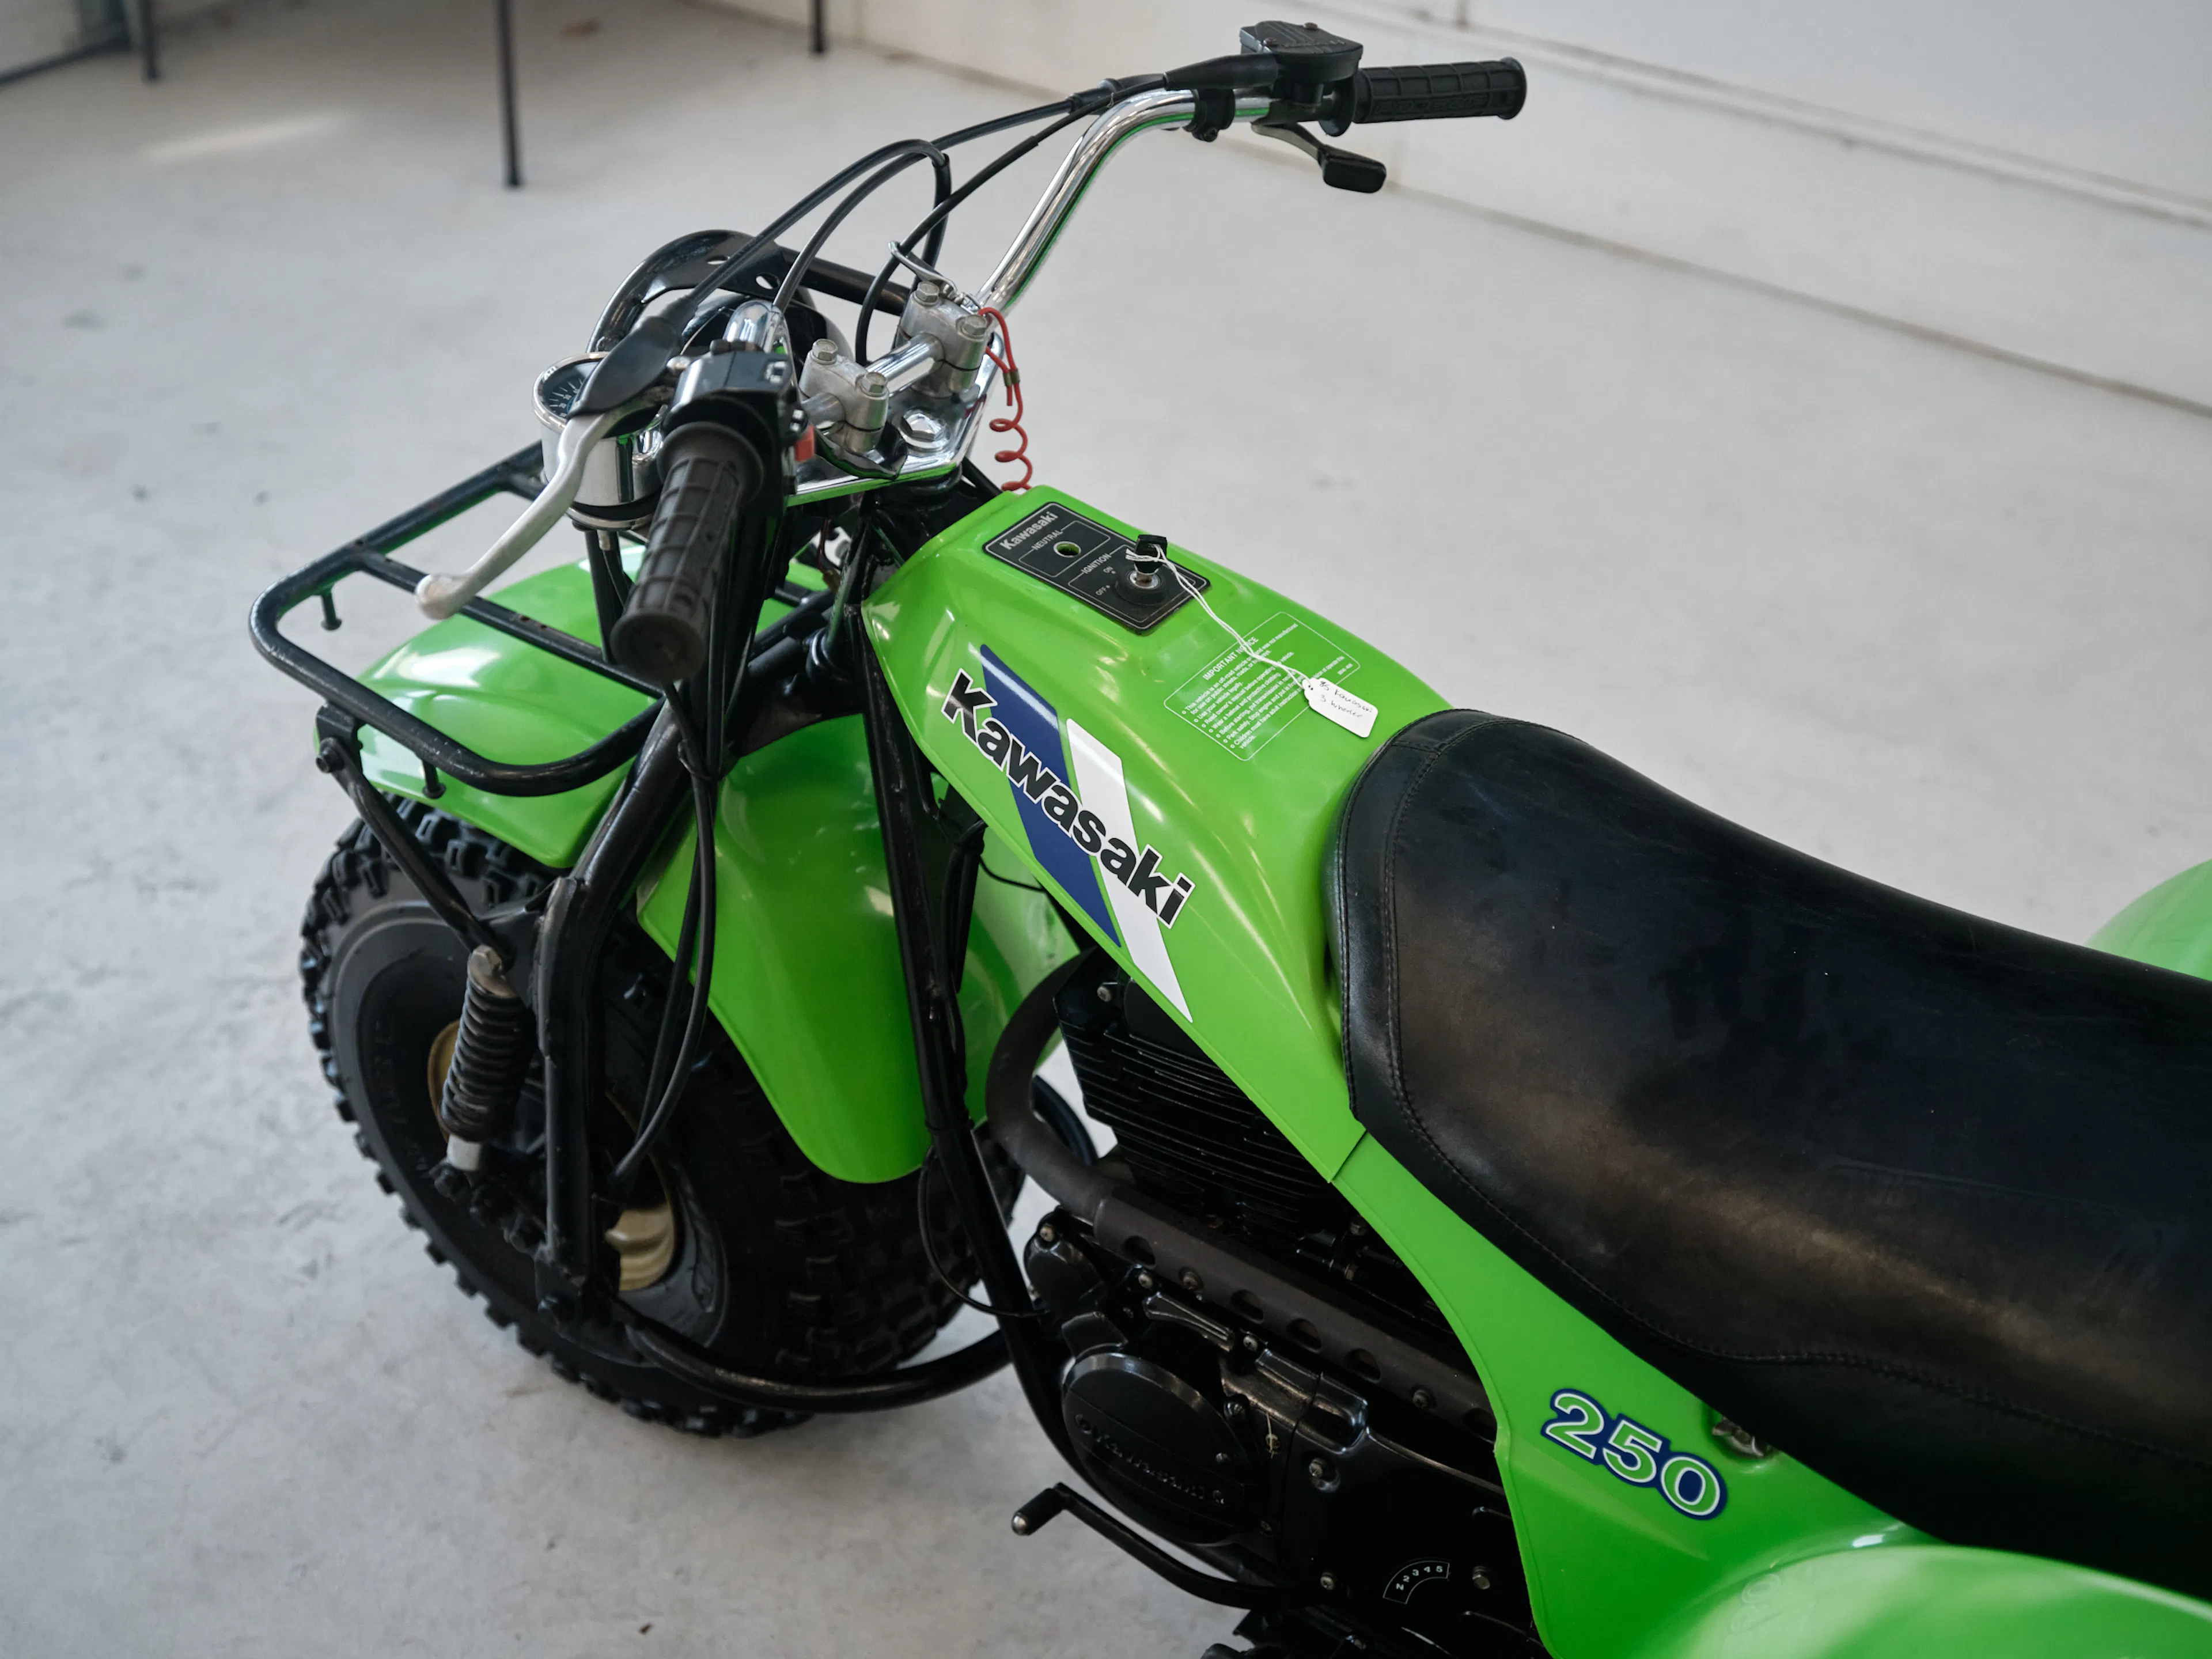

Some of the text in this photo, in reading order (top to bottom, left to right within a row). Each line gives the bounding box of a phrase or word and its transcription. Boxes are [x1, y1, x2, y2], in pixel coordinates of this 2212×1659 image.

[999, 511, 1058, 550] Kawasaki
[1031, 529, 1063, 551] NEUTRAL
[1081, 552, 1112, 574] IGNITION
[1103, 566, 1113, 574] ON
[1095, 586, 1107, 596] OFF
[1184, 702, 1197, 710] This
[1194, 690, 1211, 703] vehicle
[1218, 669, 1235, 683] off-road
[1233, 660, 1248, 671] vehicle
[1202, 652, 1237, 680] IMPORTANT
[1196, 700, 1207, 710] use
[1210, 687, 1224, 699] public
[1222, 676, 1238, 688] streets,
[1196, 681, 1243, 719] Use your vehicle legally.
[1203, 713, 1217, 724] Read
[1215, 700, 1232, 715] owner's
[1230, 688, 1246, 702] manual
[1243, 679, 1257, 690] before
[1256, 666, 1275, 680] operating
[1211, 718, 1224, 729] Wear
[1225, 704, 1241, 717] helmet
[1238, 698, 1248, 706] and
[1246, 683, 1266, 700] protective
[1218, 721, 1234, 734] Before
[1233, 709, 1251, 723] starting,
[1248, 702, 1257, 711] put
[1254, 684, 1279, 704] transmission
[1320, 694, 1327, 702] 3
[1226, 730, 1238, 740] Park
[1236, 720, 1251, 732] safely.
[1248, 711, 1260, 721] Stop
[1257, 700, 1272, 713] engine
[1270, 694, 1280, 702] and
[1278, 688, 1286, 696] put
[1233, 729, 1252, 745] Children
[1250, 721, 1262, 731] must
[1259, 713, 1271, 723] have
[1269, 705, 1280, 715] adult
[1278, 690, 1298, 707] instruction
[1239, 734, 1256, 749] vehicle.
[941, 668, 1196, 929] Kawasaki
[1540, 1388, 1728, 1521] 250
[1403, 1575, 1410, 1583] 2
[1412, 1569, 1419, 1577] 3
[1435, 1565, 1443, 1573] 5
